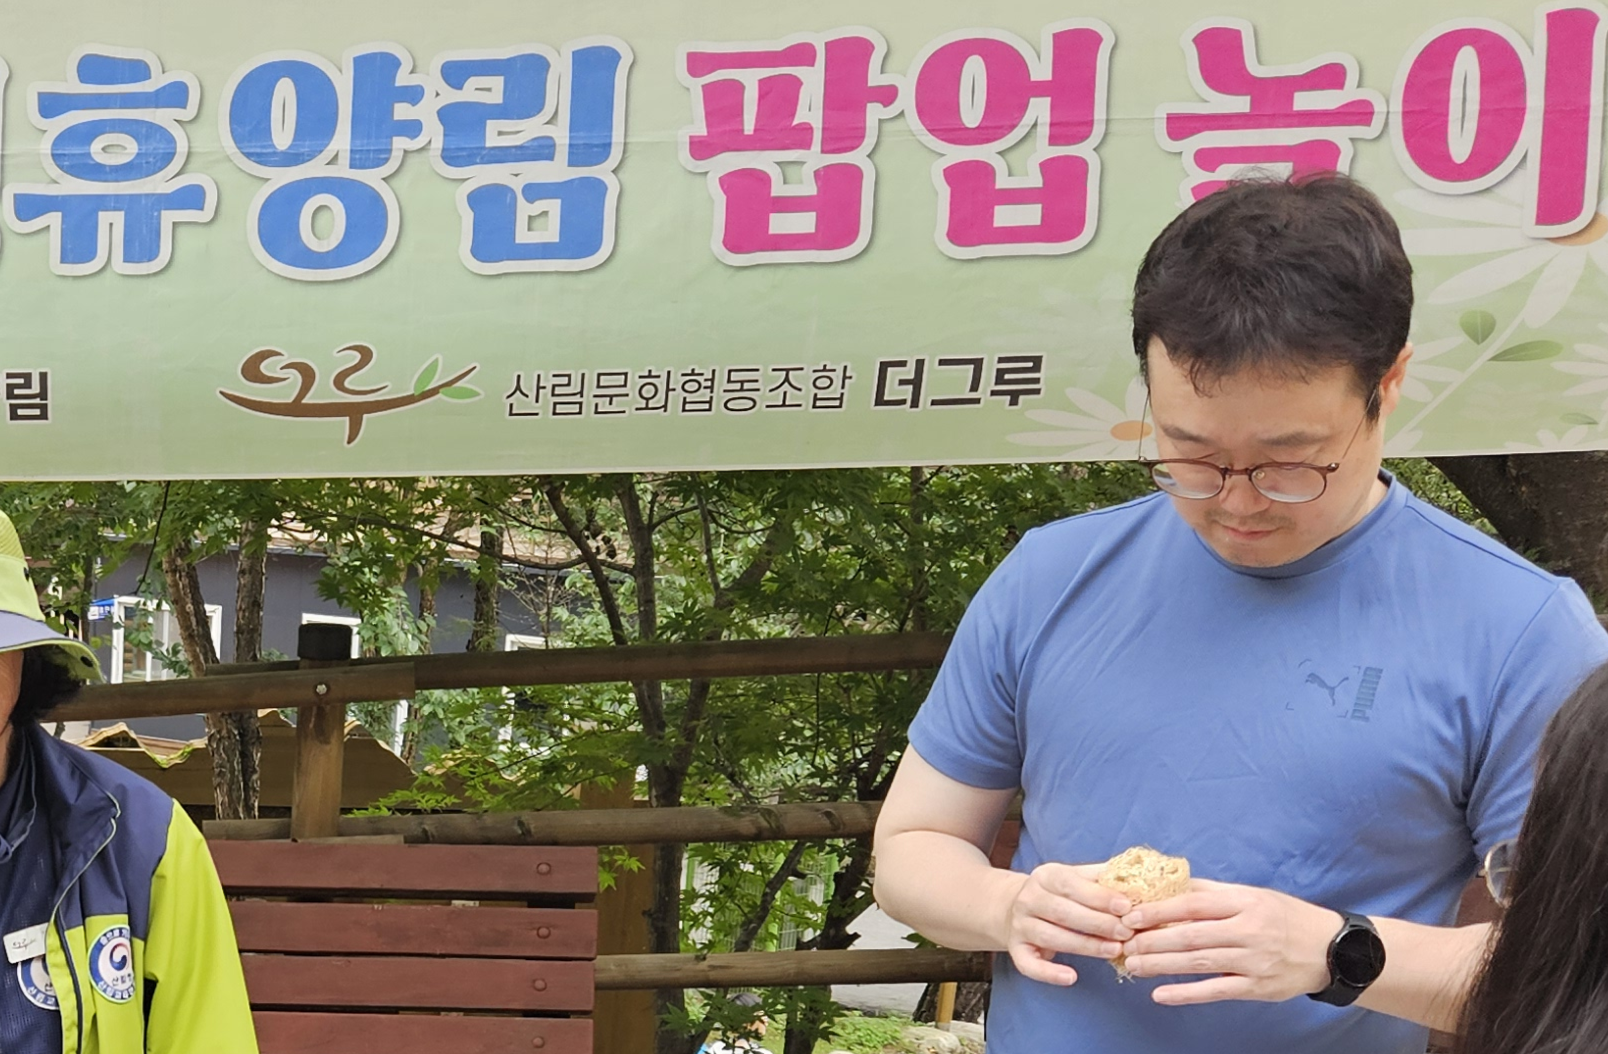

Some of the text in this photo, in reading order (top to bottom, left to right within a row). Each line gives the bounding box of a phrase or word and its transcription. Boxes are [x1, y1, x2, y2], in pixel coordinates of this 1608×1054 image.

[682, 25, 1106, 257] 팝업
[1164, 6, 1602, 227] 놀이
[503, 355, 1044, 417] 산림문화협동조합 더그루
